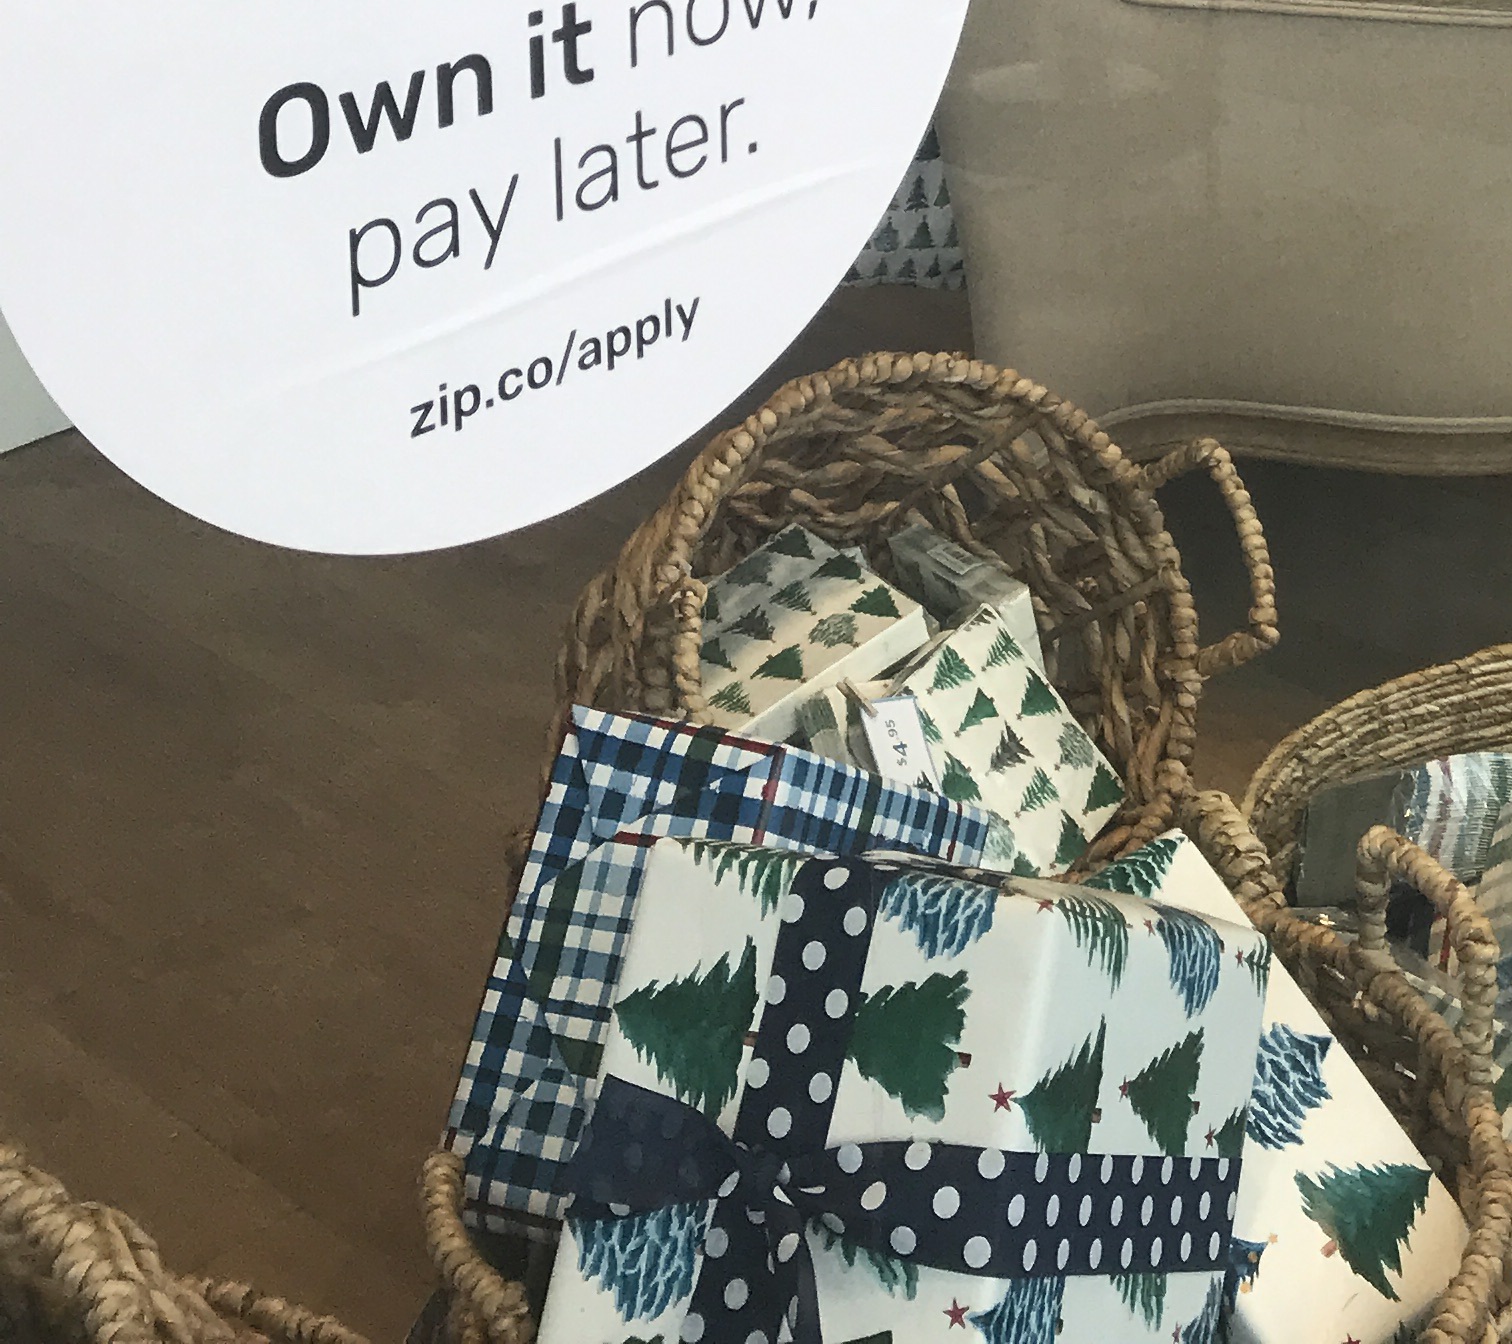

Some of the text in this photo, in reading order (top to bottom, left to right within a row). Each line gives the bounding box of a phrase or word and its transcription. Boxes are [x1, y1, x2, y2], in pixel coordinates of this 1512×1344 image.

[256, 51, 494, 180] Own
[525, 1, 595, 99] it
[348, 93, 760, 316] pay later.
[410, 296, 701, 439] zip.co/apply
